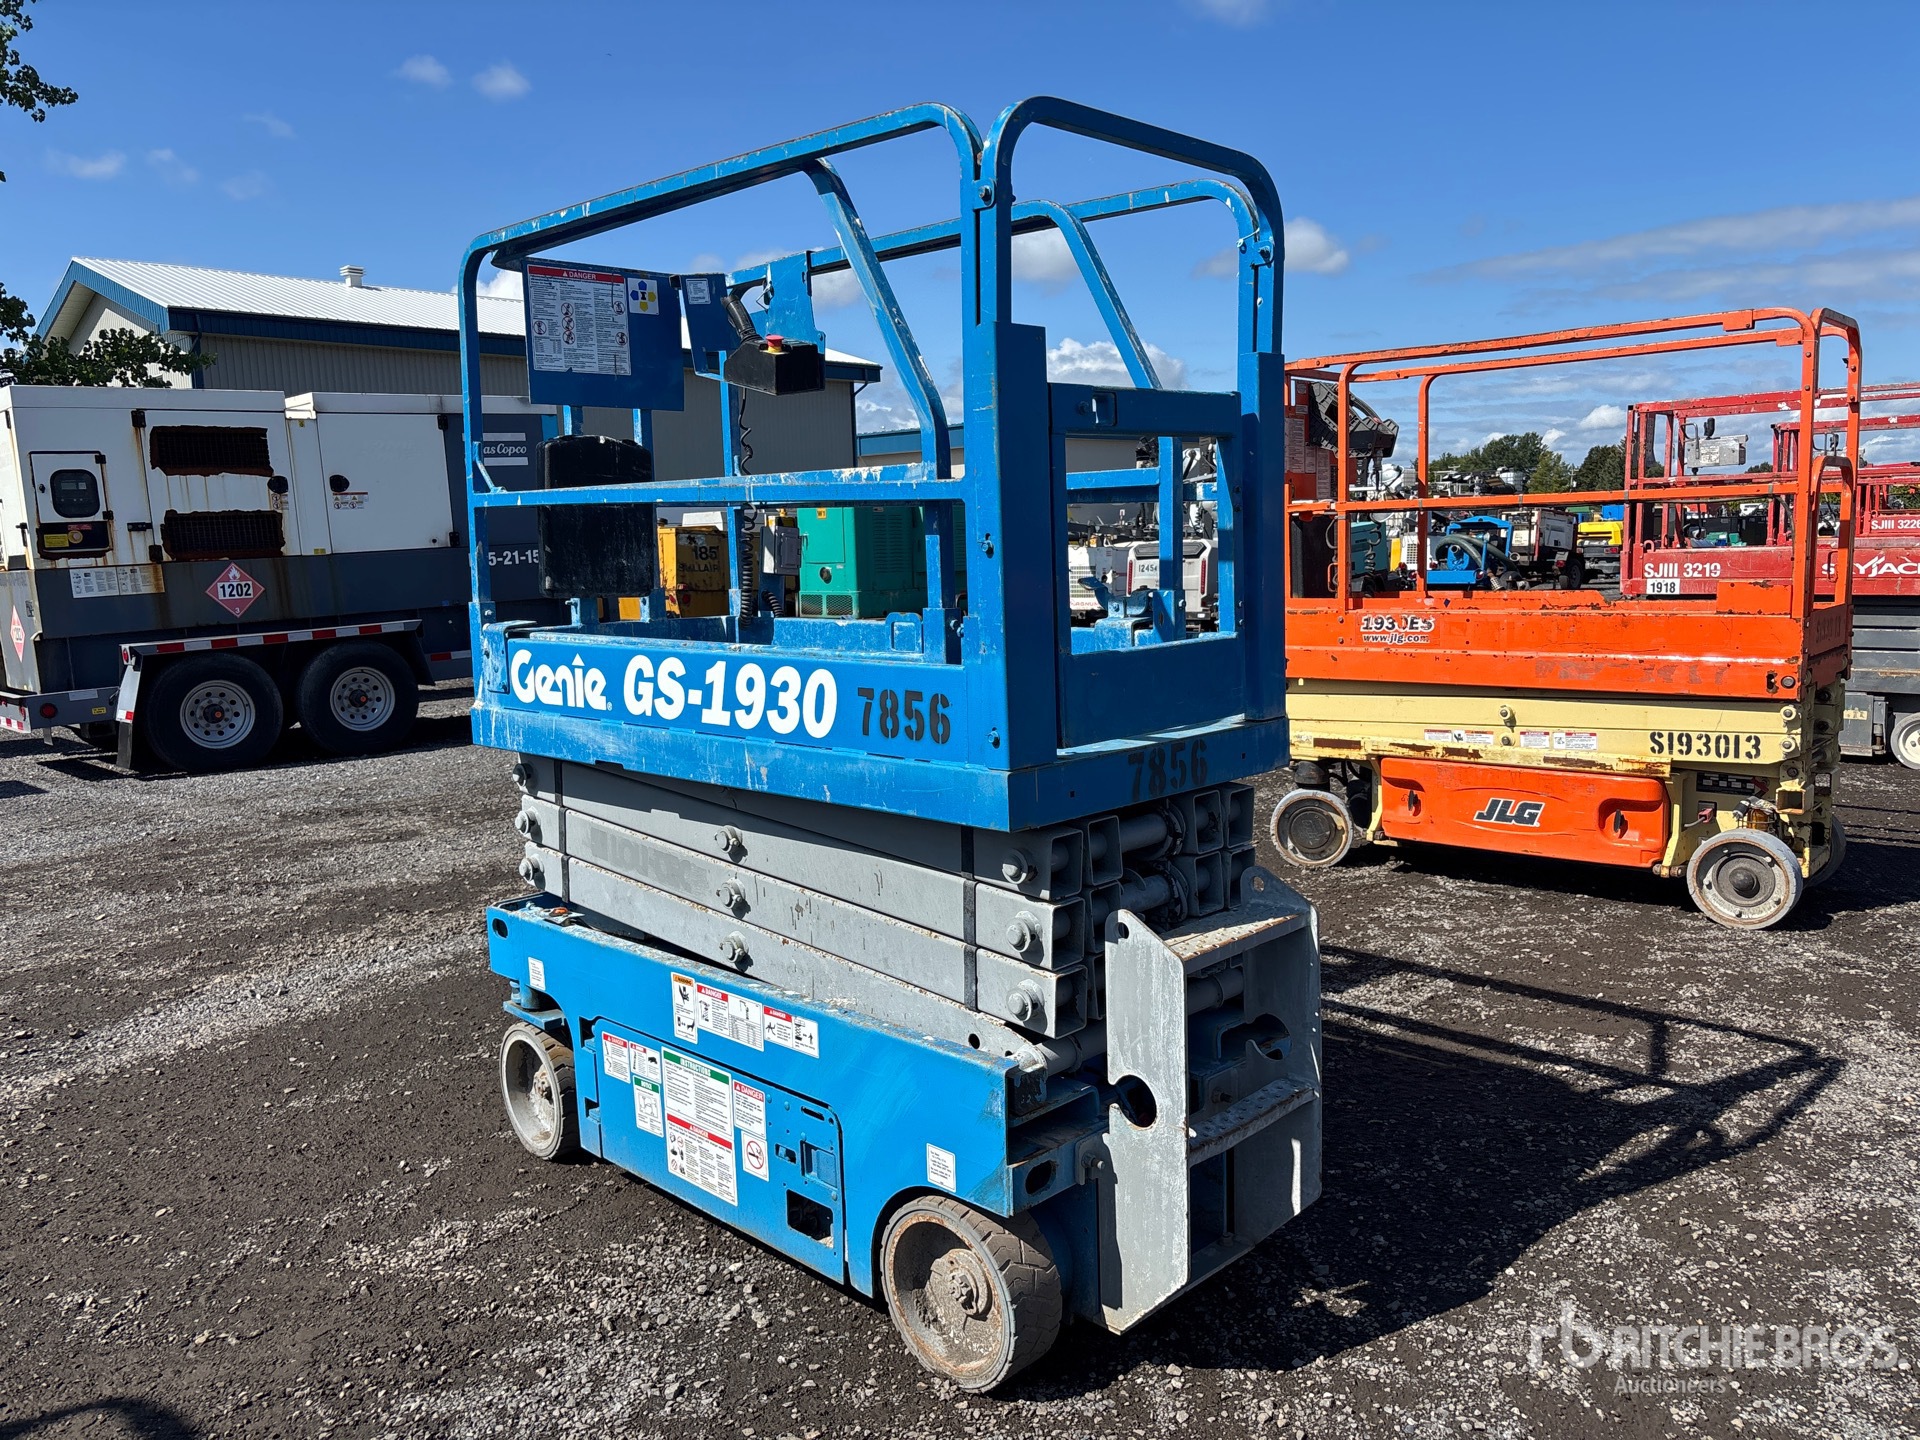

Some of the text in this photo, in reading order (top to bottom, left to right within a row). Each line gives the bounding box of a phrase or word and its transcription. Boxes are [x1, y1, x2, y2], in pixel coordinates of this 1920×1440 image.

[569, 271, 597, 280] DANGER
[496, 443, 527, 456] Copco
[693, 545, 719, 560] 185
[1644, 562, 1721, 578] SJIII 3219
[219, 582, 252, 598] 1202
[1650, 581, 1676, 593] 1918
[1363, 633, 1430, 644] www.jlg.com
[511, 649, 838, 739] Genie GS-1930
[857, 687, 952, 745] 7856
[1650, 731, 1761, 760] S193013
[1127, 738, 1208, 801] 7856
[1473, 798, 1544, 826] JLG
[741, 1085, 763, 1100] DANGER
